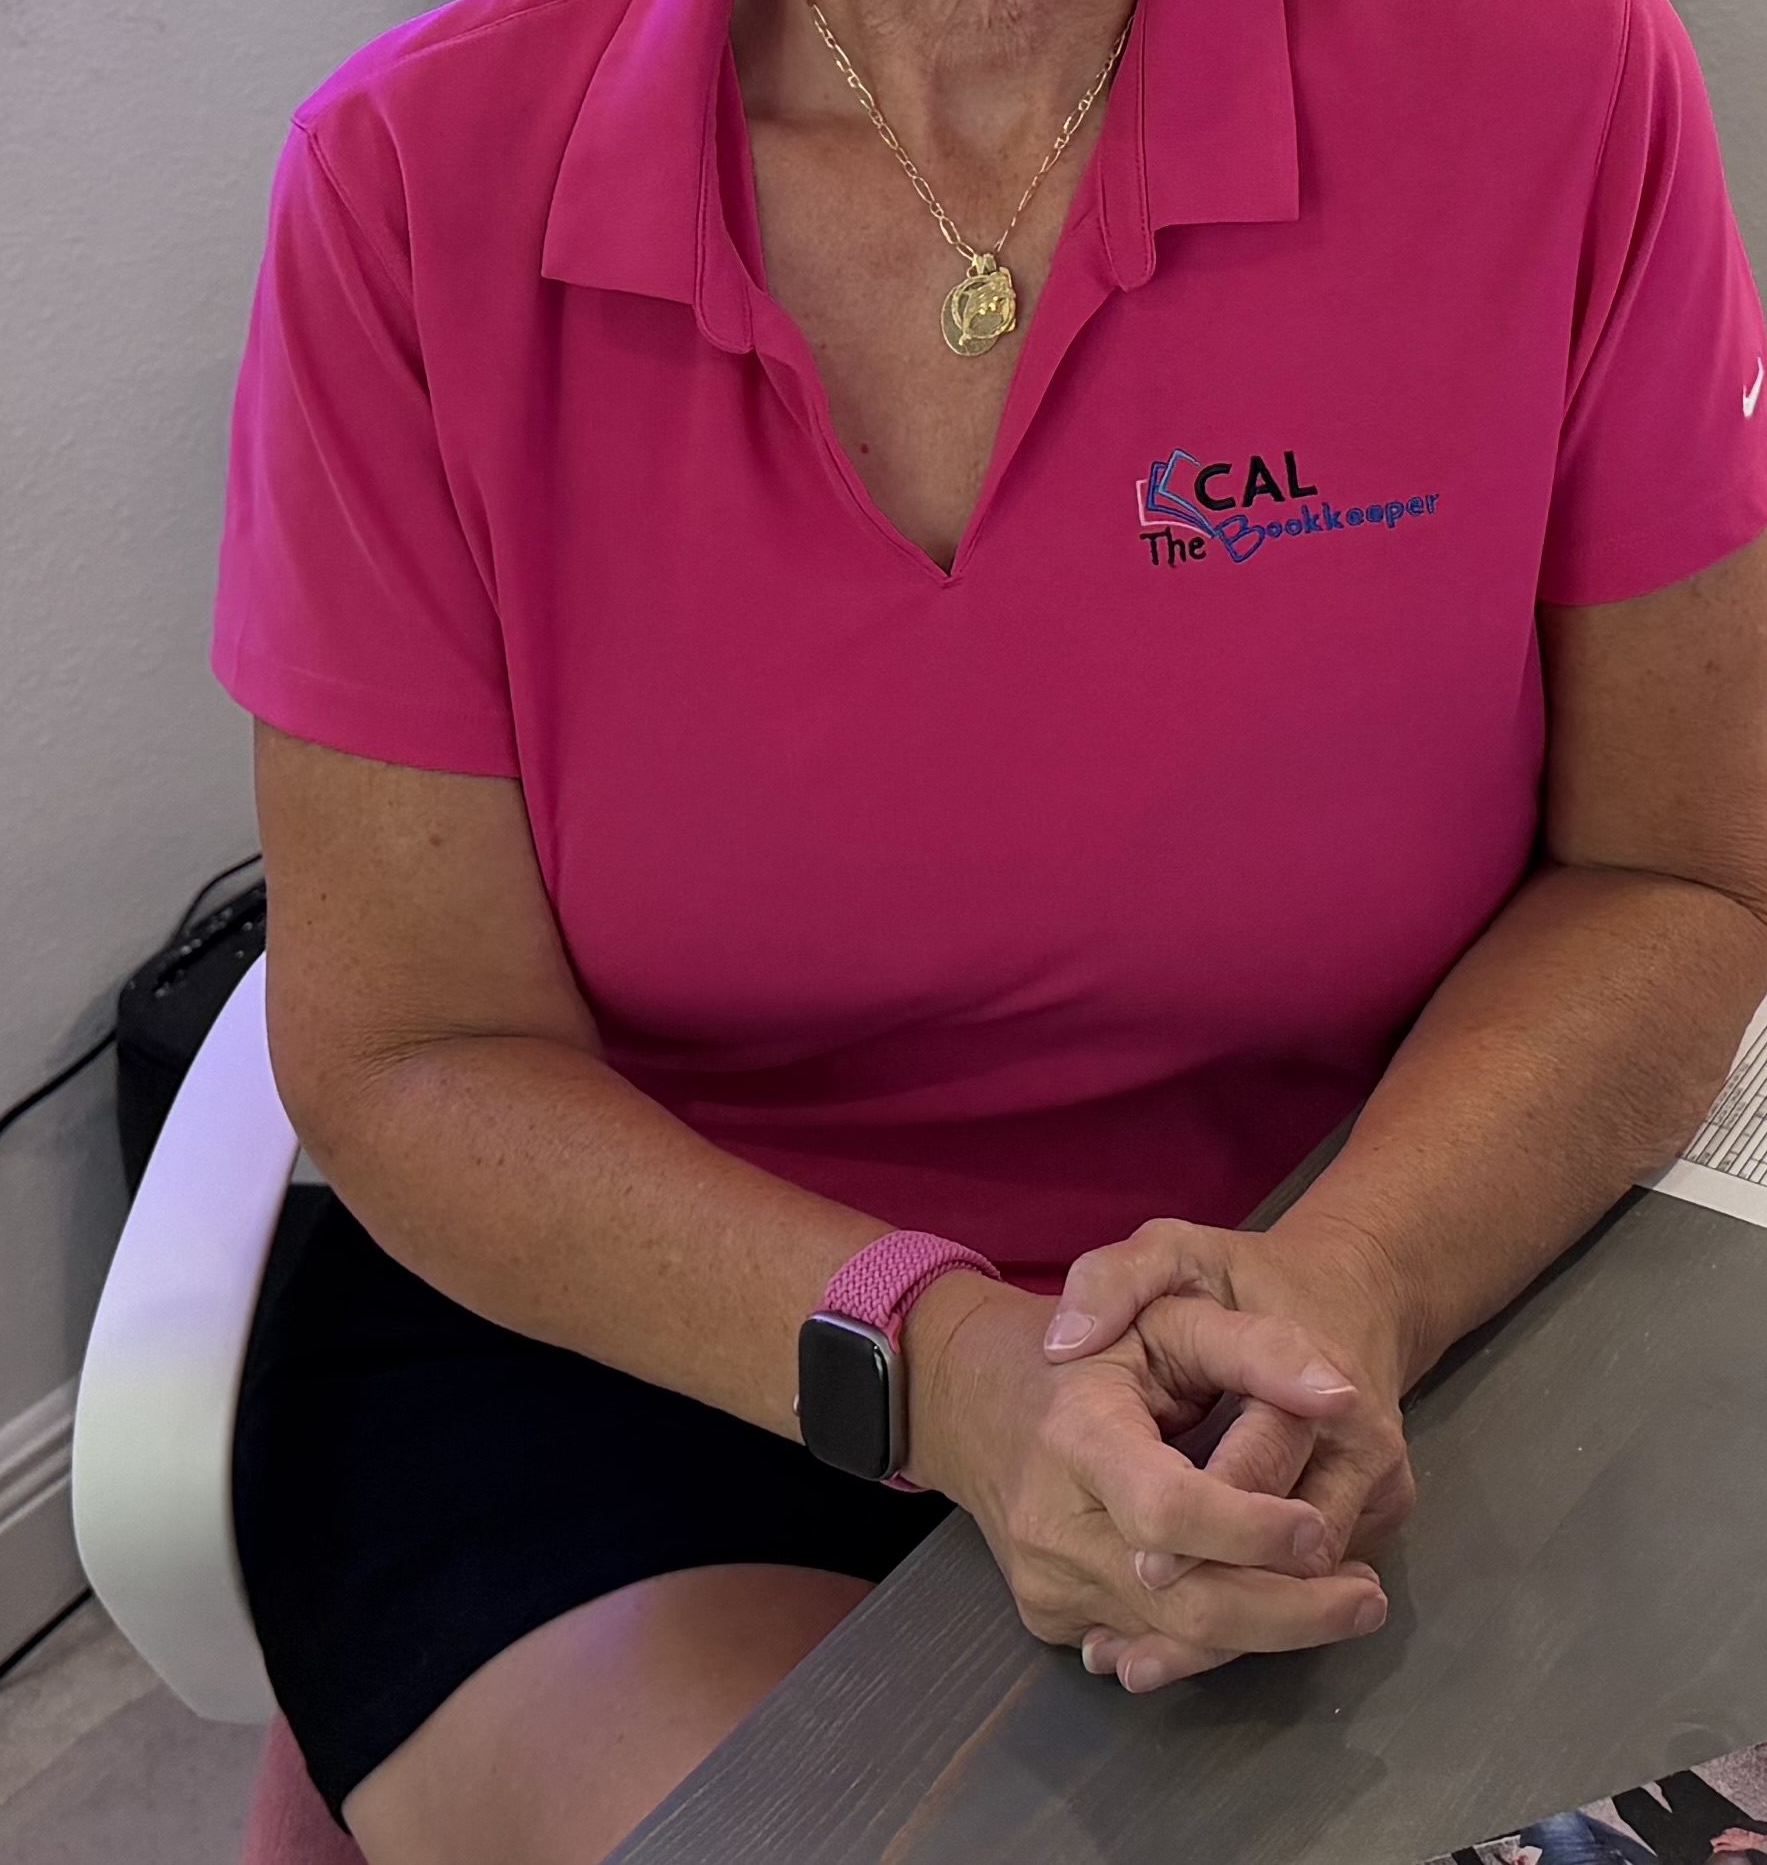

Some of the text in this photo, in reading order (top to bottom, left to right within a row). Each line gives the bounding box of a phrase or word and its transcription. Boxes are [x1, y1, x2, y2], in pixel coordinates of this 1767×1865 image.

[1193, 450, 1319, 511] CAL
[1140, 493, 1440, 566] The Bookkeeper
